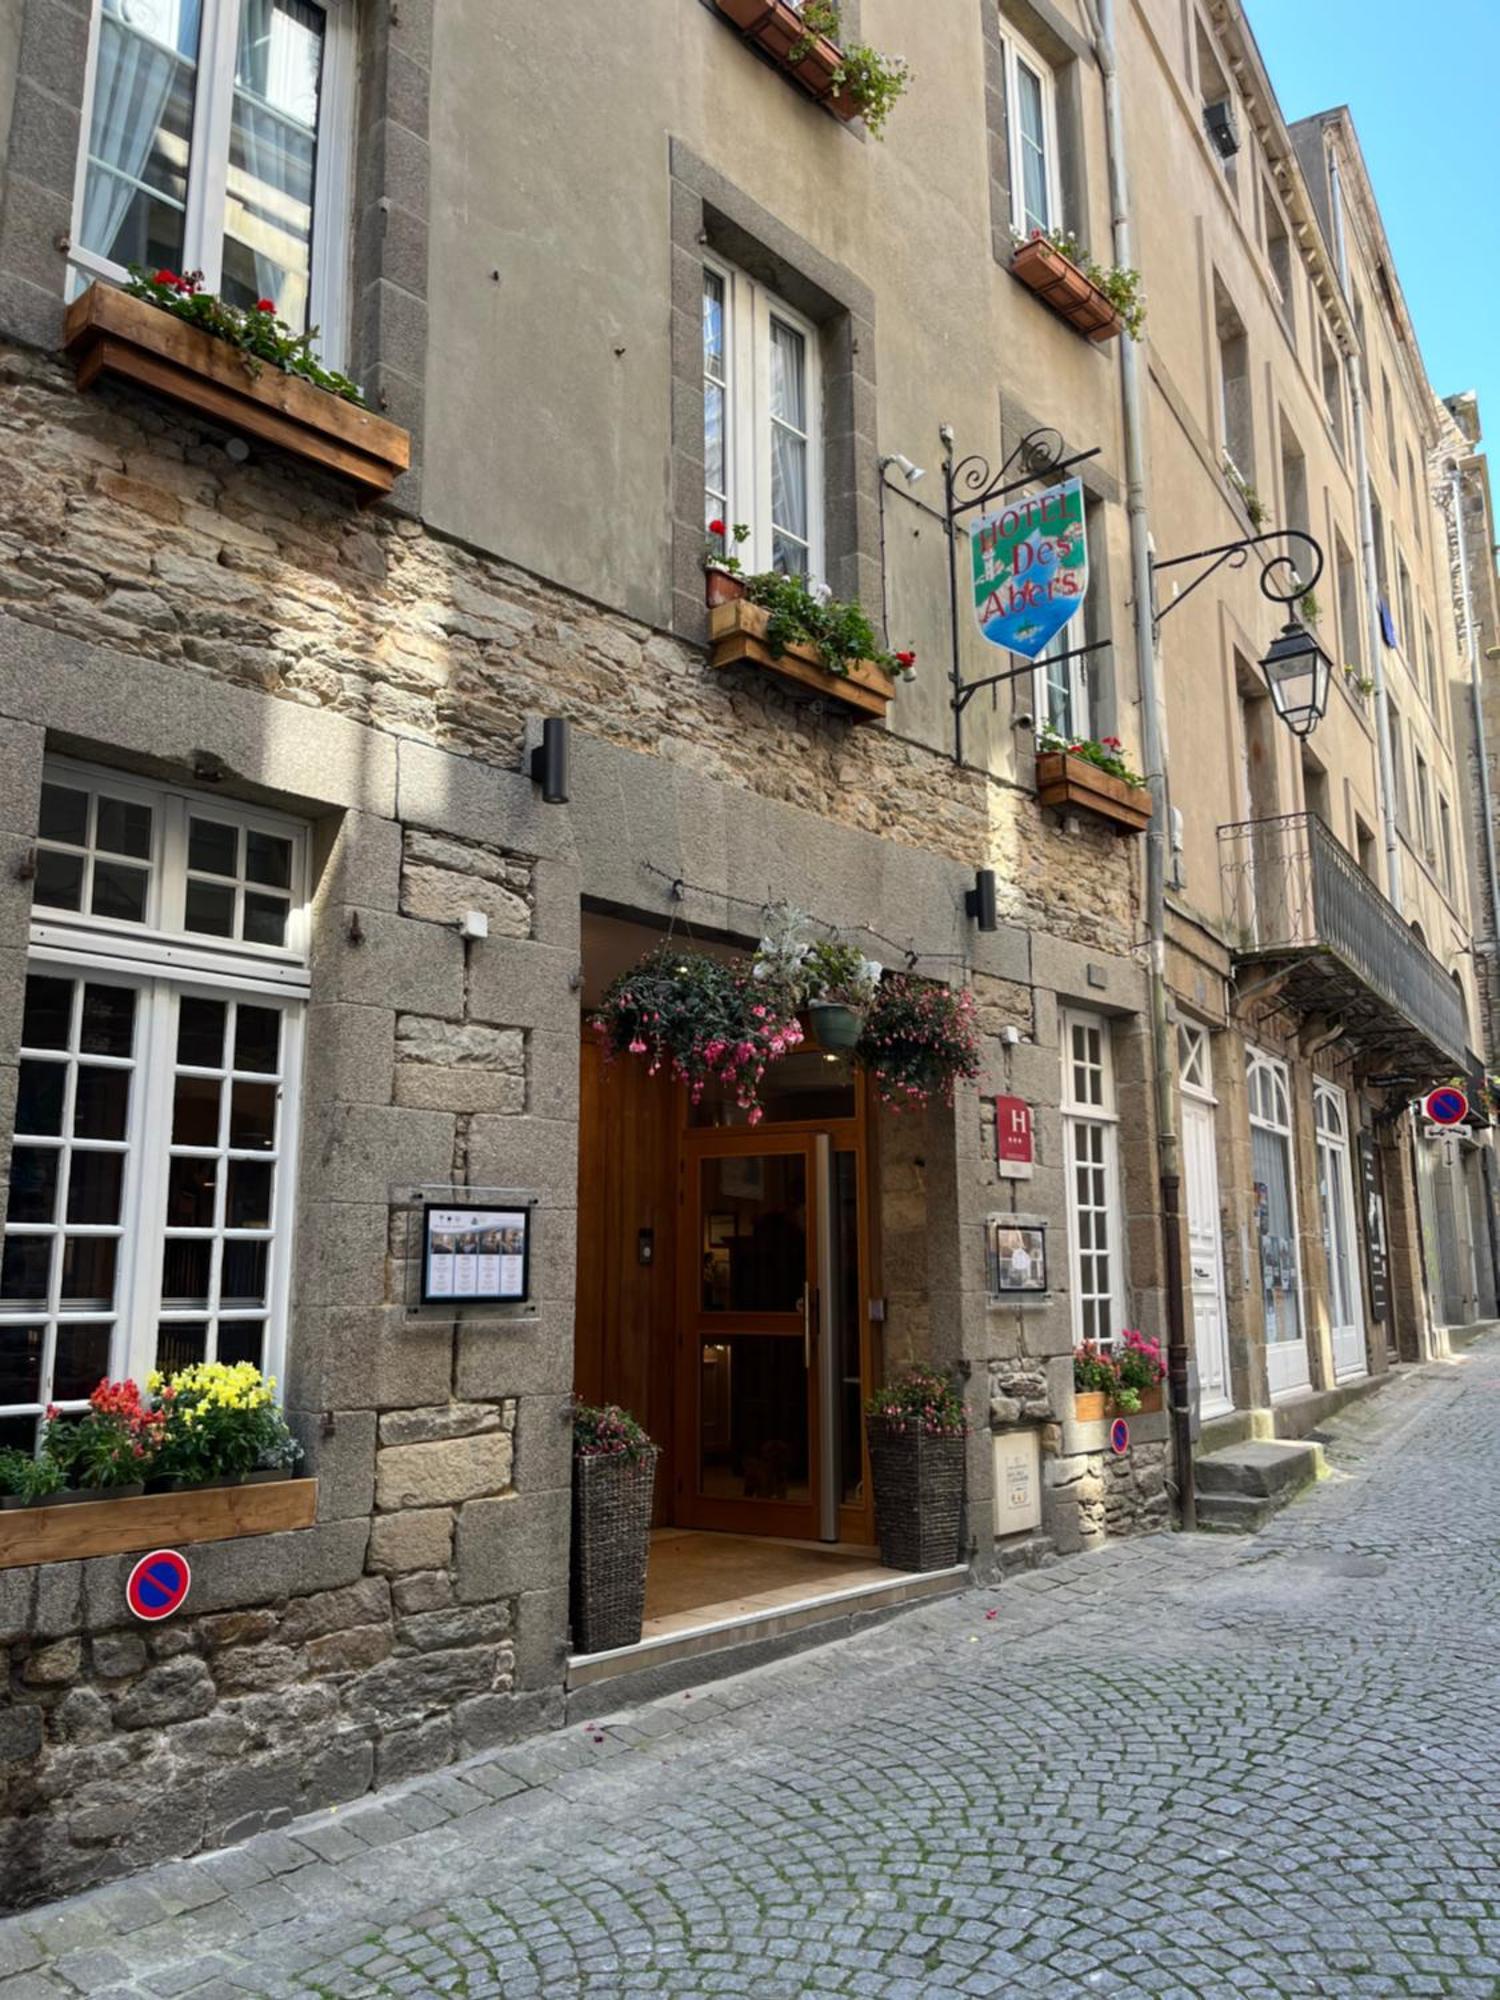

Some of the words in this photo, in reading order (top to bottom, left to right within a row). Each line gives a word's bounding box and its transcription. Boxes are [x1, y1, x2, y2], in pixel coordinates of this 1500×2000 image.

[979, 493, 1075, 553] HOTEL
[1011, 534, 1072, 576] Des
[979, 572, 1079, 624] Abers
[1012, 1109, 1027, 1133] H
